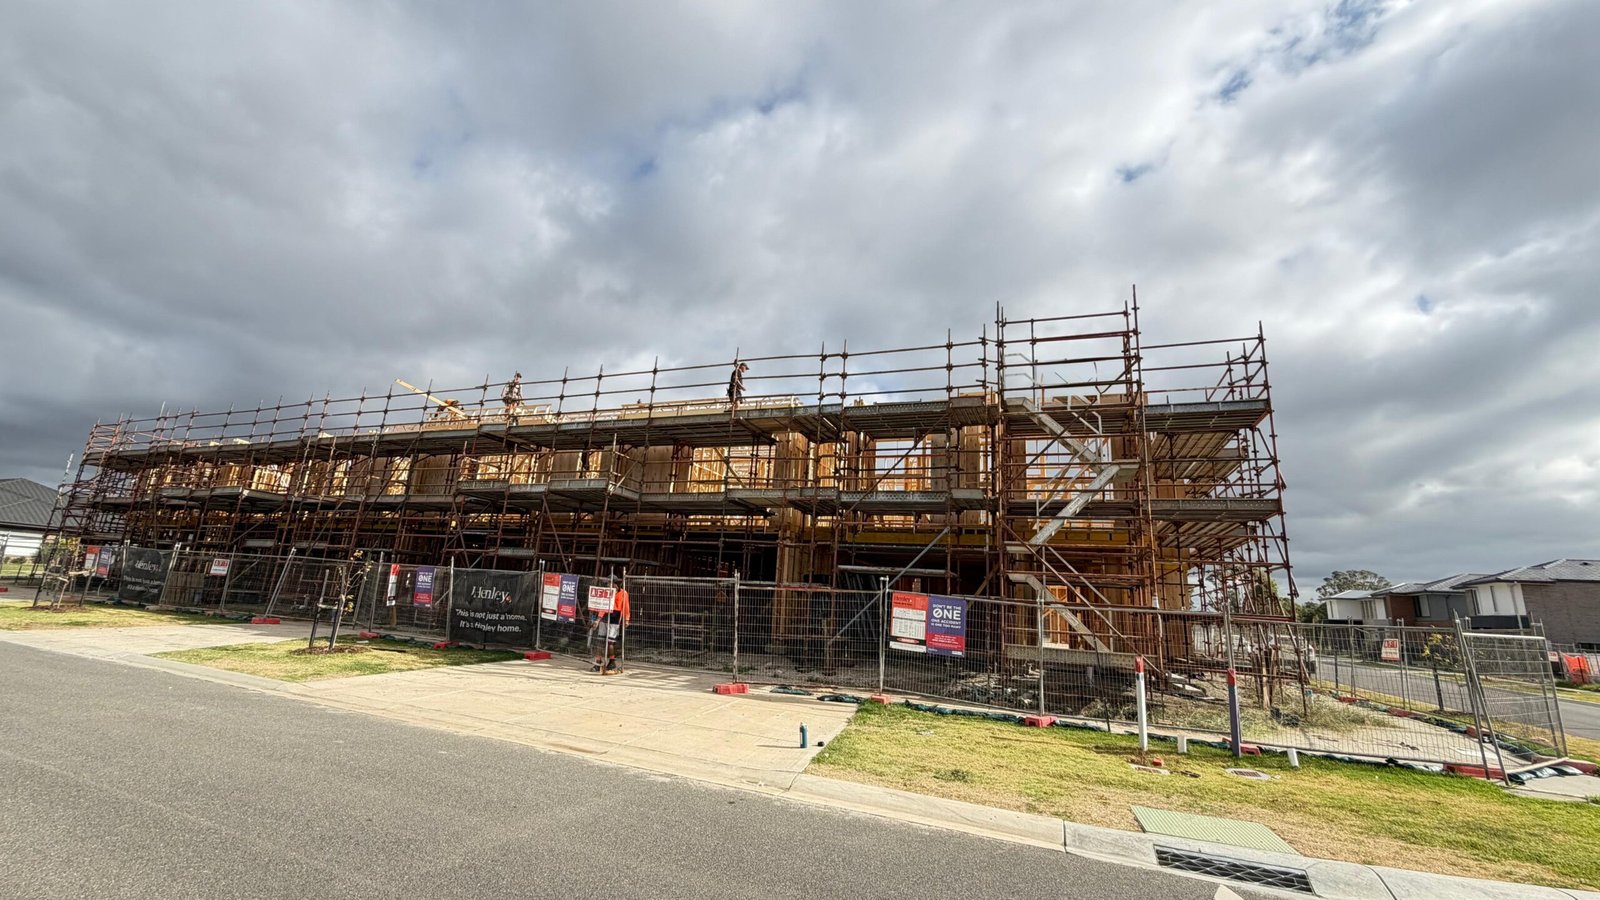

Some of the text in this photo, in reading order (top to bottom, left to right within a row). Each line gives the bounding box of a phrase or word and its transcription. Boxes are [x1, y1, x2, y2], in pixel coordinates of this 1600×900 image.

[418, 574, 432, 582] ONE
[562, 584, 575, 593] ONE
[471, 586, 509, 603] Henley
[456, 608, 469, 617] This
[486, 612, 499, 620] just
[933, 608, 961, 620] ONE
[497, 624, 522, 632] home.
